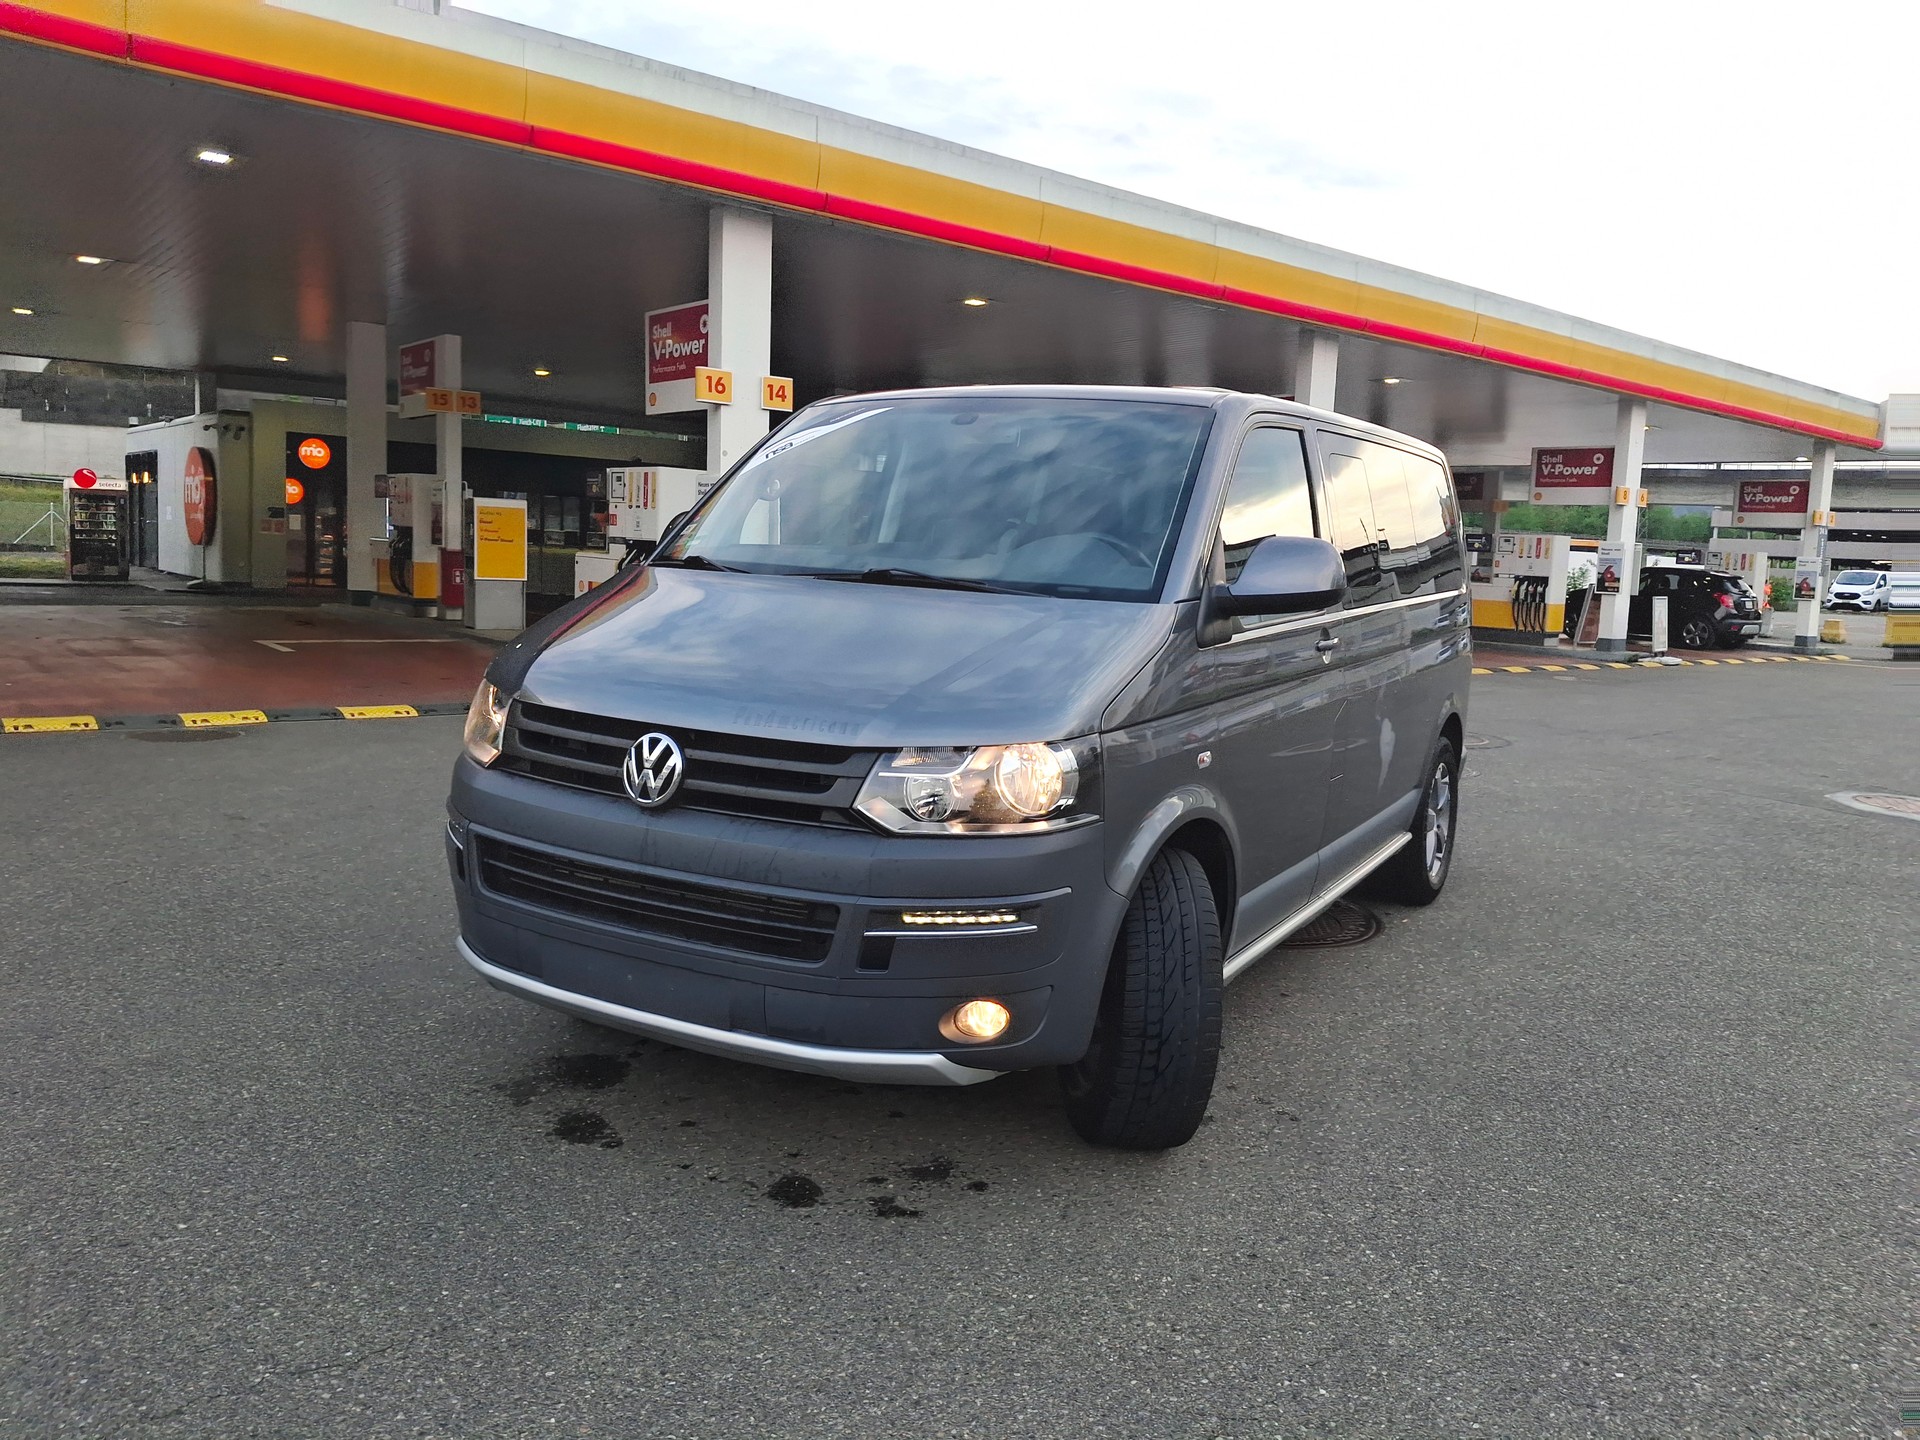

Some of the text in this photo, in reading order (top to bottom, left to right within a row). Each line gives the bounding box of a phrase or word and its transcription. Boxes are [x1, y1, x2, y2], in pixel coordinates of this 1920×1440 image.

[652, 321, 672, 339] Shell
[653, 338, 706, 360] V-Power
[705, 375, 727, 395] 16
[767, 383, 787, 402] 14
[431, 393, 448, 406] 15
[460, 396, 478, 409] 13
[301, 444, 325, 457] mio
[1541, 454, 1563, 464] Shell
[1541, 463, 1599, 476] V-Power
[1743, 485, 1763, 493] Shell
[1743, 493, 1795, 503] V-Power
[625, 733, 681, 804] VW
